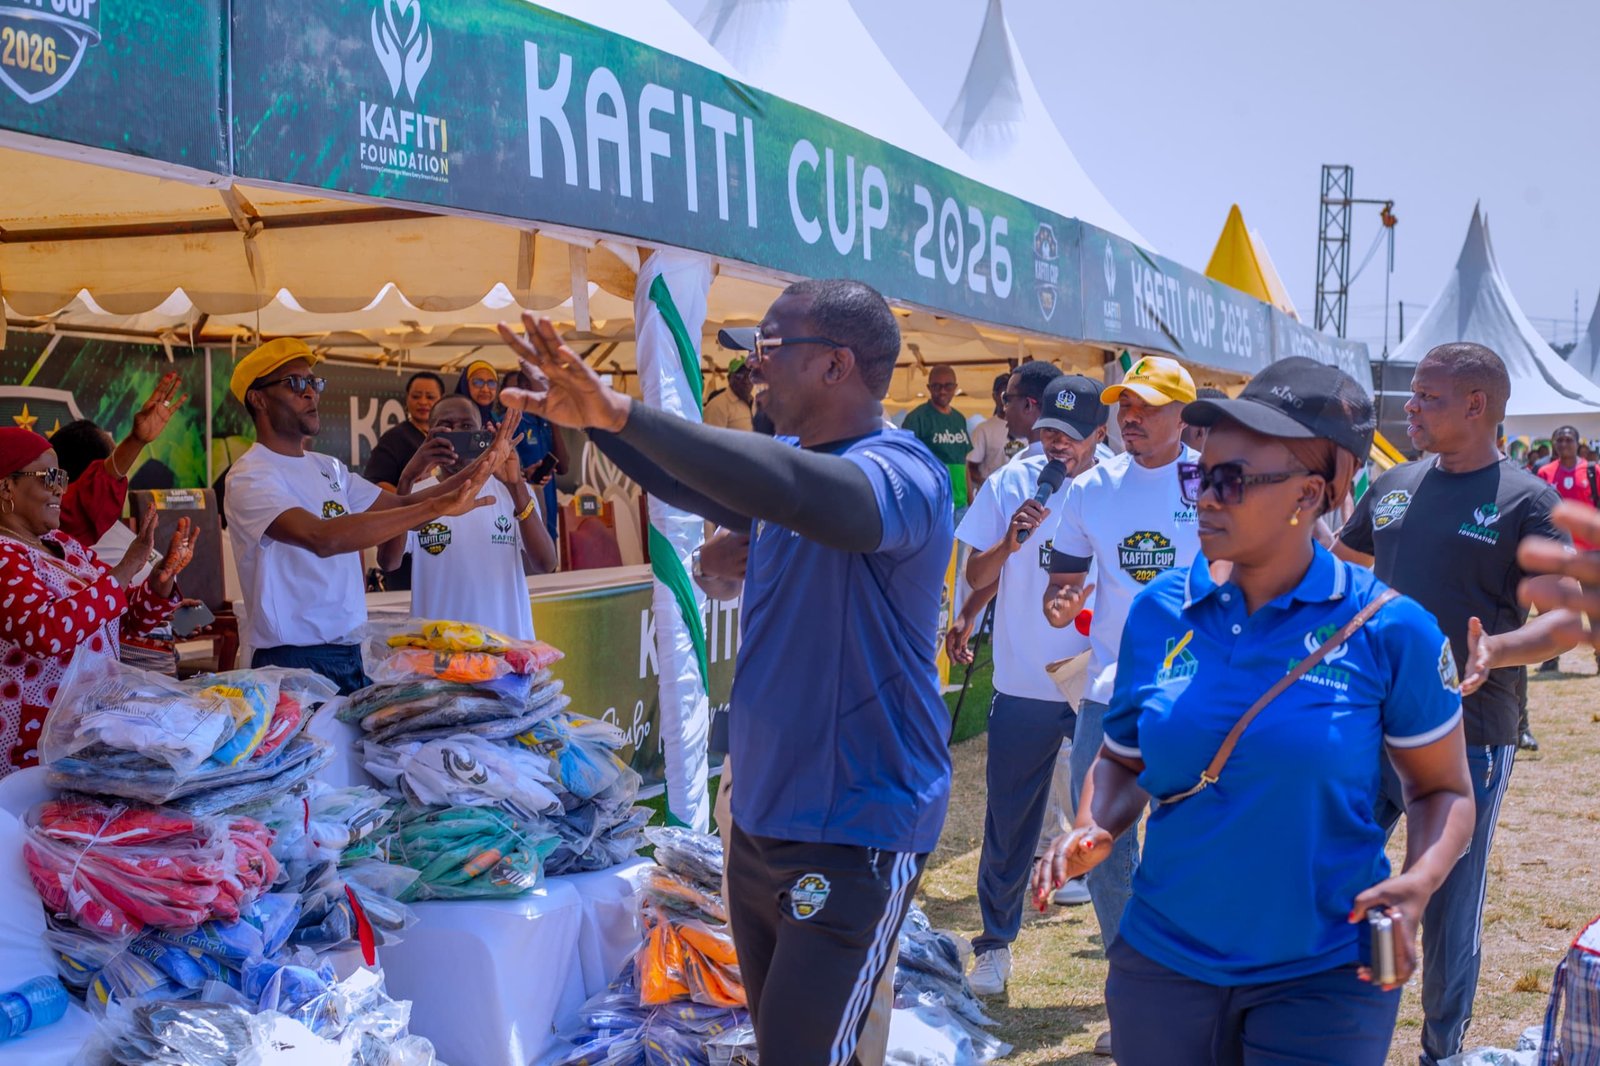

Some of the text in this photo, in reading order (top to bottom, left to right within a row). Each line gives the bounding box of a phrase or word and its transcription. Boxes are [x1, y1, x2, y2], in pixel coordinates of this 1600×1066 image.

[2, 26, 57, 76] 2026
[360, 101, 447, 153] KAFITI
[360, 142, 448, 175] FOUNDATION
[524, 40, 1013, 299] KAFITI CUP 2026
[1131, 260, 1252, 358] KAFITI CUP 2026
[439, 533, 451, 542] CUP
[1458, 529, 1496, 545] FOUNDATION
[1461, 523, 1499, 540] KAFITI
[1121, 551, 1174, 565] KAFITI CUP
[1288, 658, 1350, 684] KFITI
